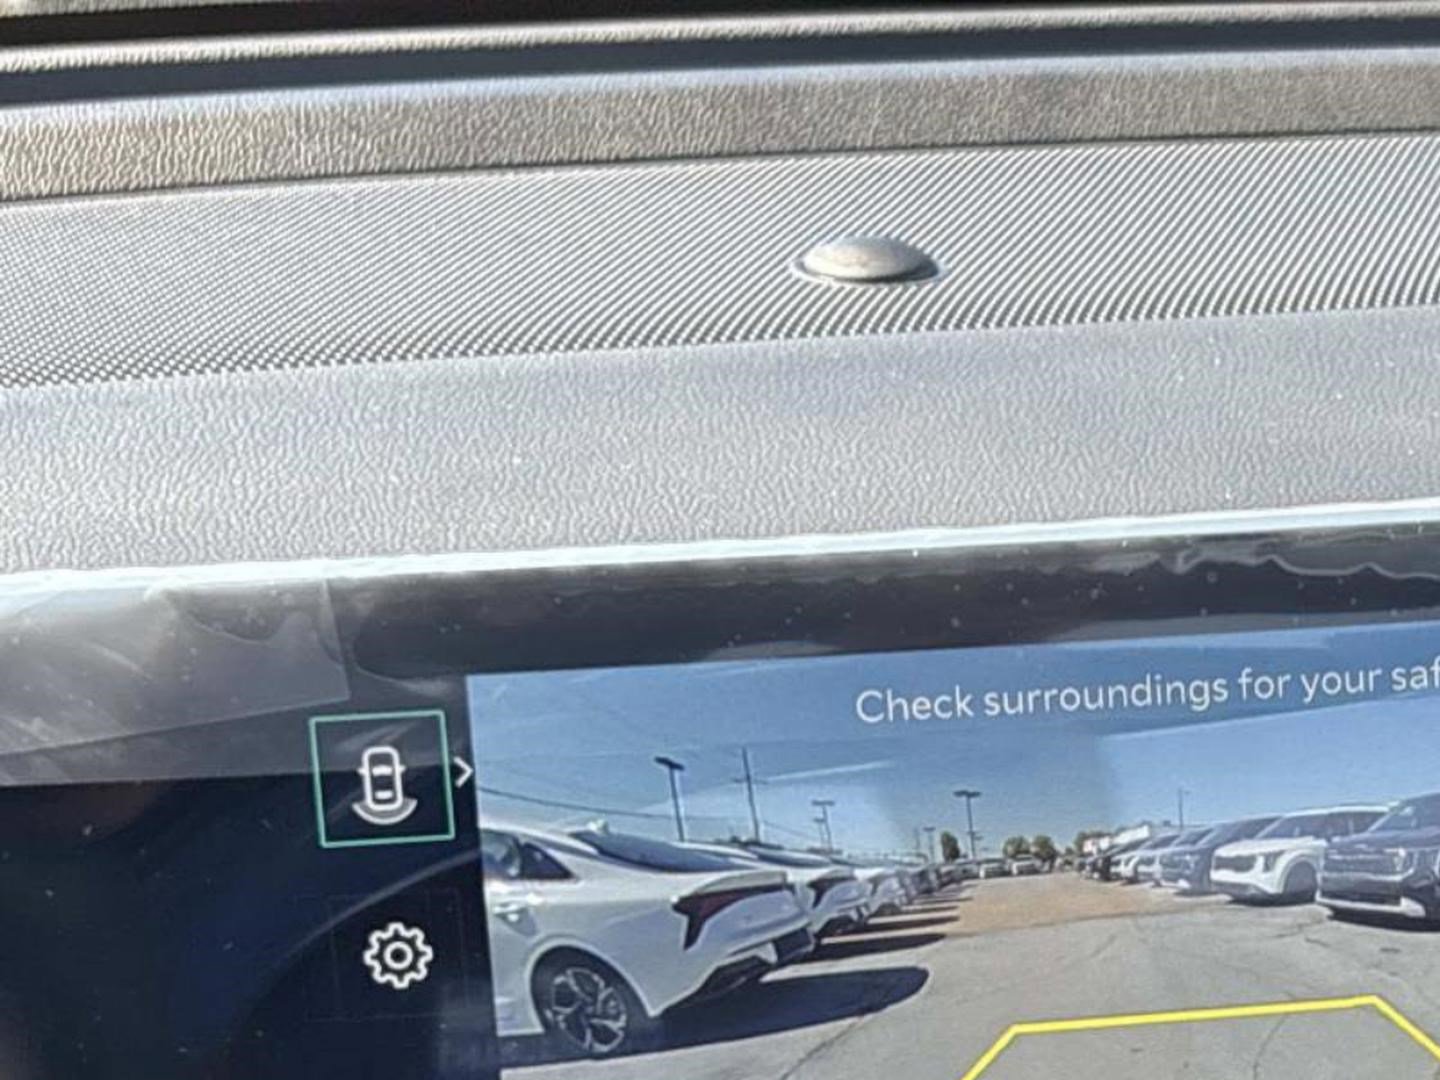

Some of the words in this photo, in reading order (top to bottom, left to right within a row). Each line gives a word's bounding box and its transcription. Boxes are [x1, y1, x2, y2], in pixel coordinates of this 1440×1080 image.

[855, 689, 974, 724] Check
[982, 677, 1229, 711] surroundings
[1236, 667, 1292, 700] for
[1300, 662, 1382, 700] your
